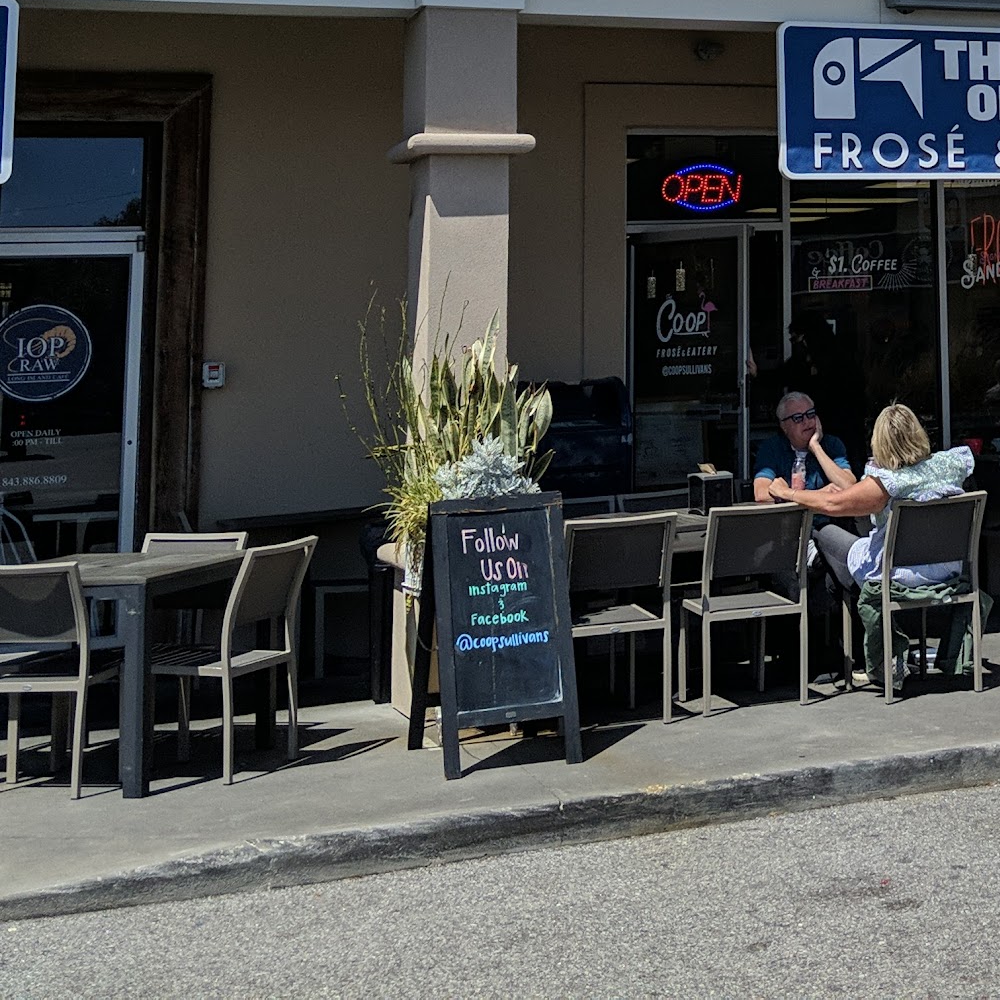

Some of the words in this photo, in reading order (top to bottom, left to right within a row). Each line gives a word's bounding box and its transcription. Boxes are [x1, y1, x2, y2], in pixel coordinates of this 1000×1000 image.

[813, 124, 966, 169] FROSÉ
[662, 174, 744, 202] OPEN
[812, 276, 869, 290] BREAKFAST
[17, 337, 65, 358] IOP
[20, 358, 60, 372] RAW
[10, 429, 34, 438] OPEN
[35, 428, 61, 437] DAILY
[25, 438, 38, 446] PM
[2, 475, 67, 486] 843.886.8809
[461, 527, 519, 554] Follow
[480, 558, 503, 581] Us
[506, 556, 529, 580] On
[471, 610, 529, 626] Facebook
[456, 629, 549, 653] @coopsullivans
